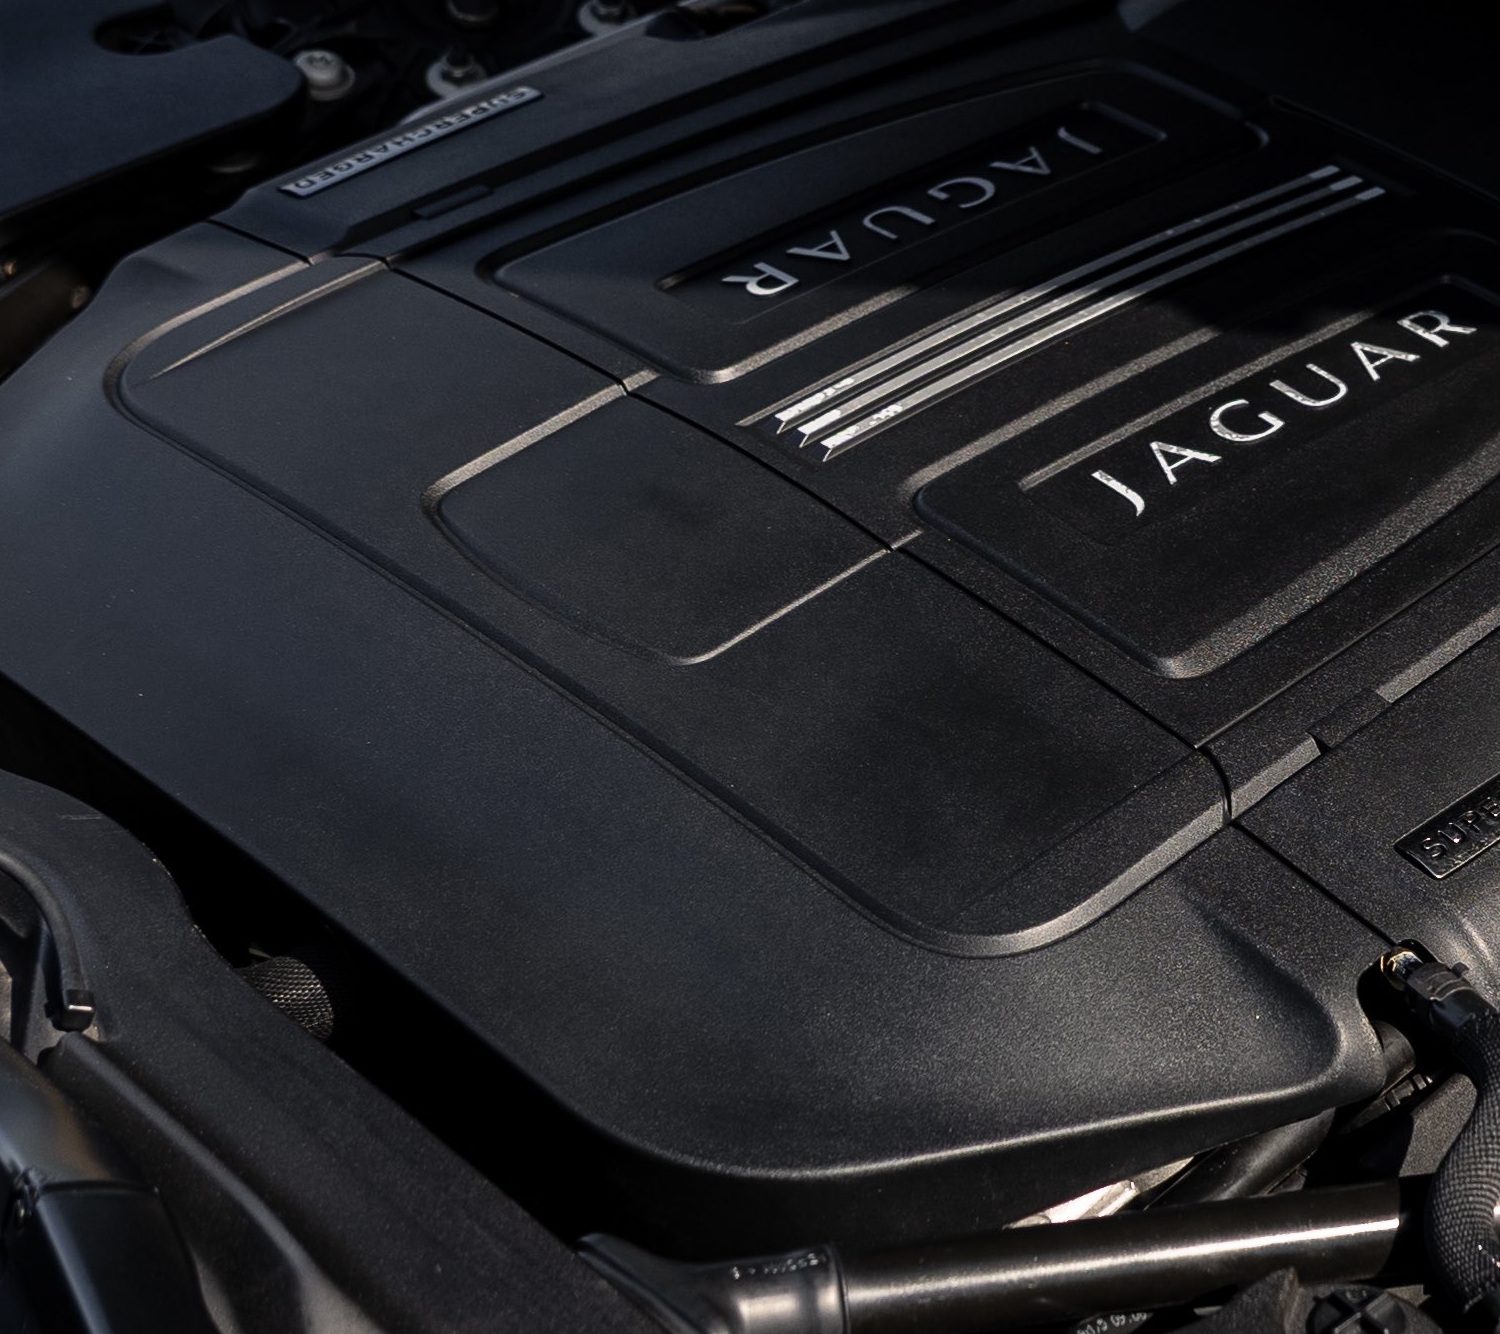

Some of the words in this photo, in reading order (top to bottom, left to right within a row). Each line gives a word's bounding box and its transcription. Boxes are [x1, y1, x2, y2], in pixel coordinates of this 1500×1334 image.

[296, 90, 527, 190] SUPERCHARGED
[721, 124, 1106, 300] JAGUAR
[1089, 306, 1479, 517] JAGUAR
